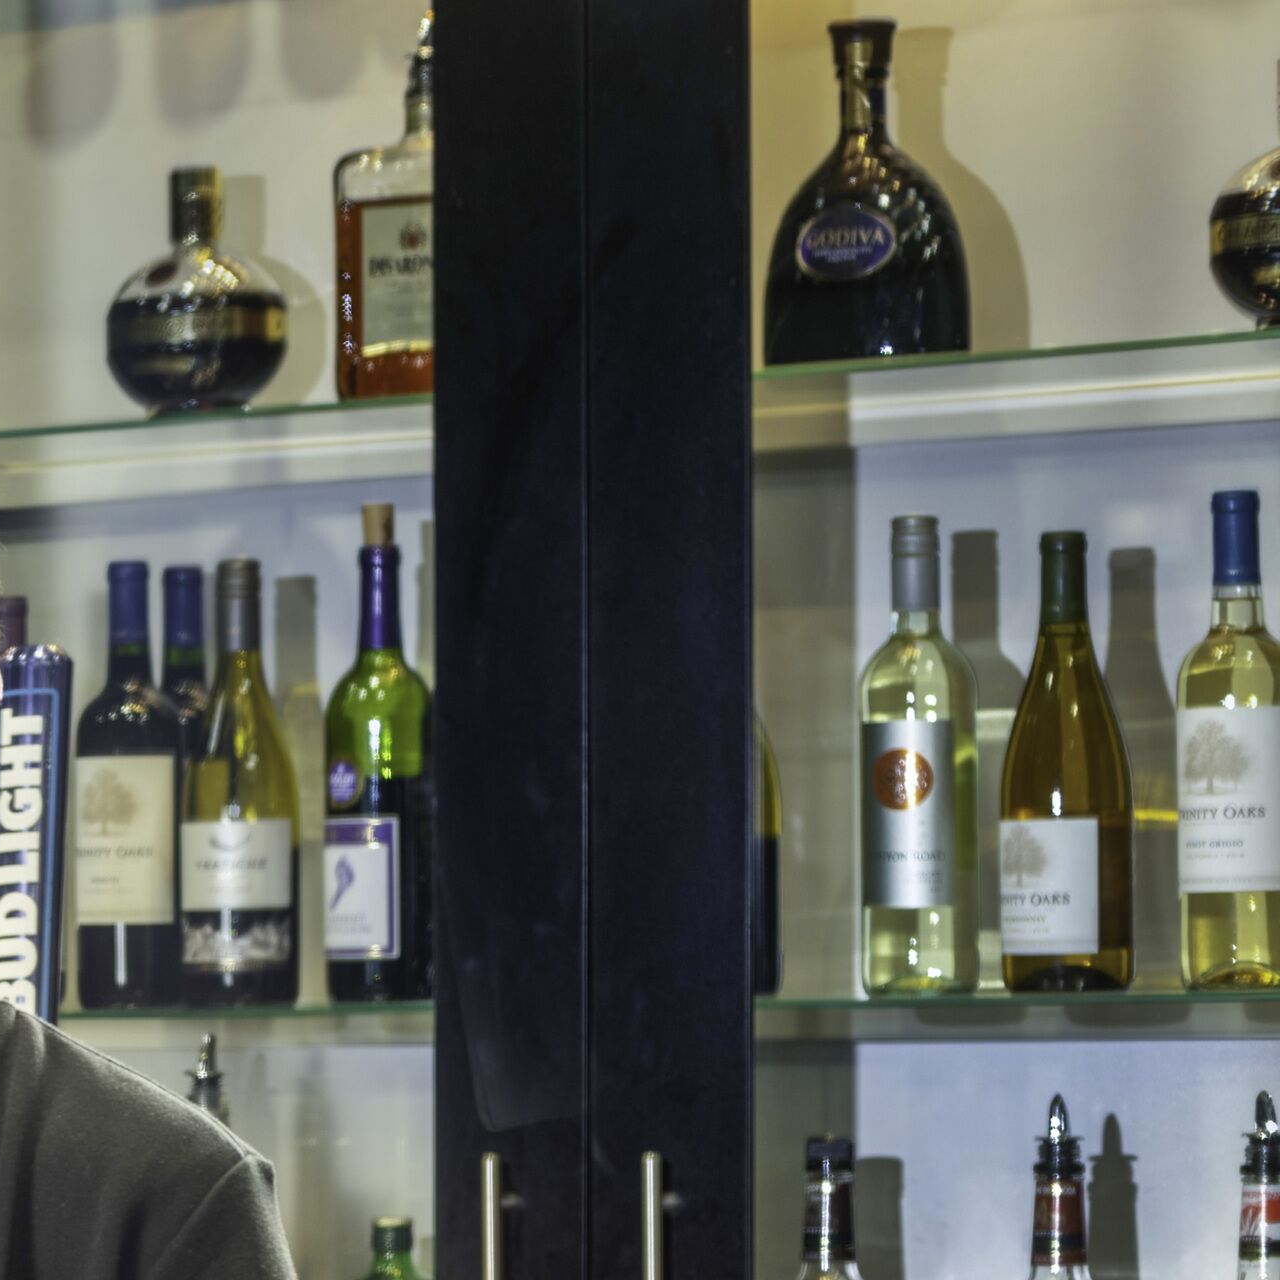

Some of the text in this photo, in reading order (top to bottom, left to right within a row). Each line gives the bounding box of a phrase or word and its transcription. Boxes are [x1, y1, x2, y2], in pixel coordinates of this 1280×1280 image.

[805, 225, 884, 252] GODIVA
[1223, 806, 1266, 819] OAKS
[1030, 893, 1071, 906] OAKS
